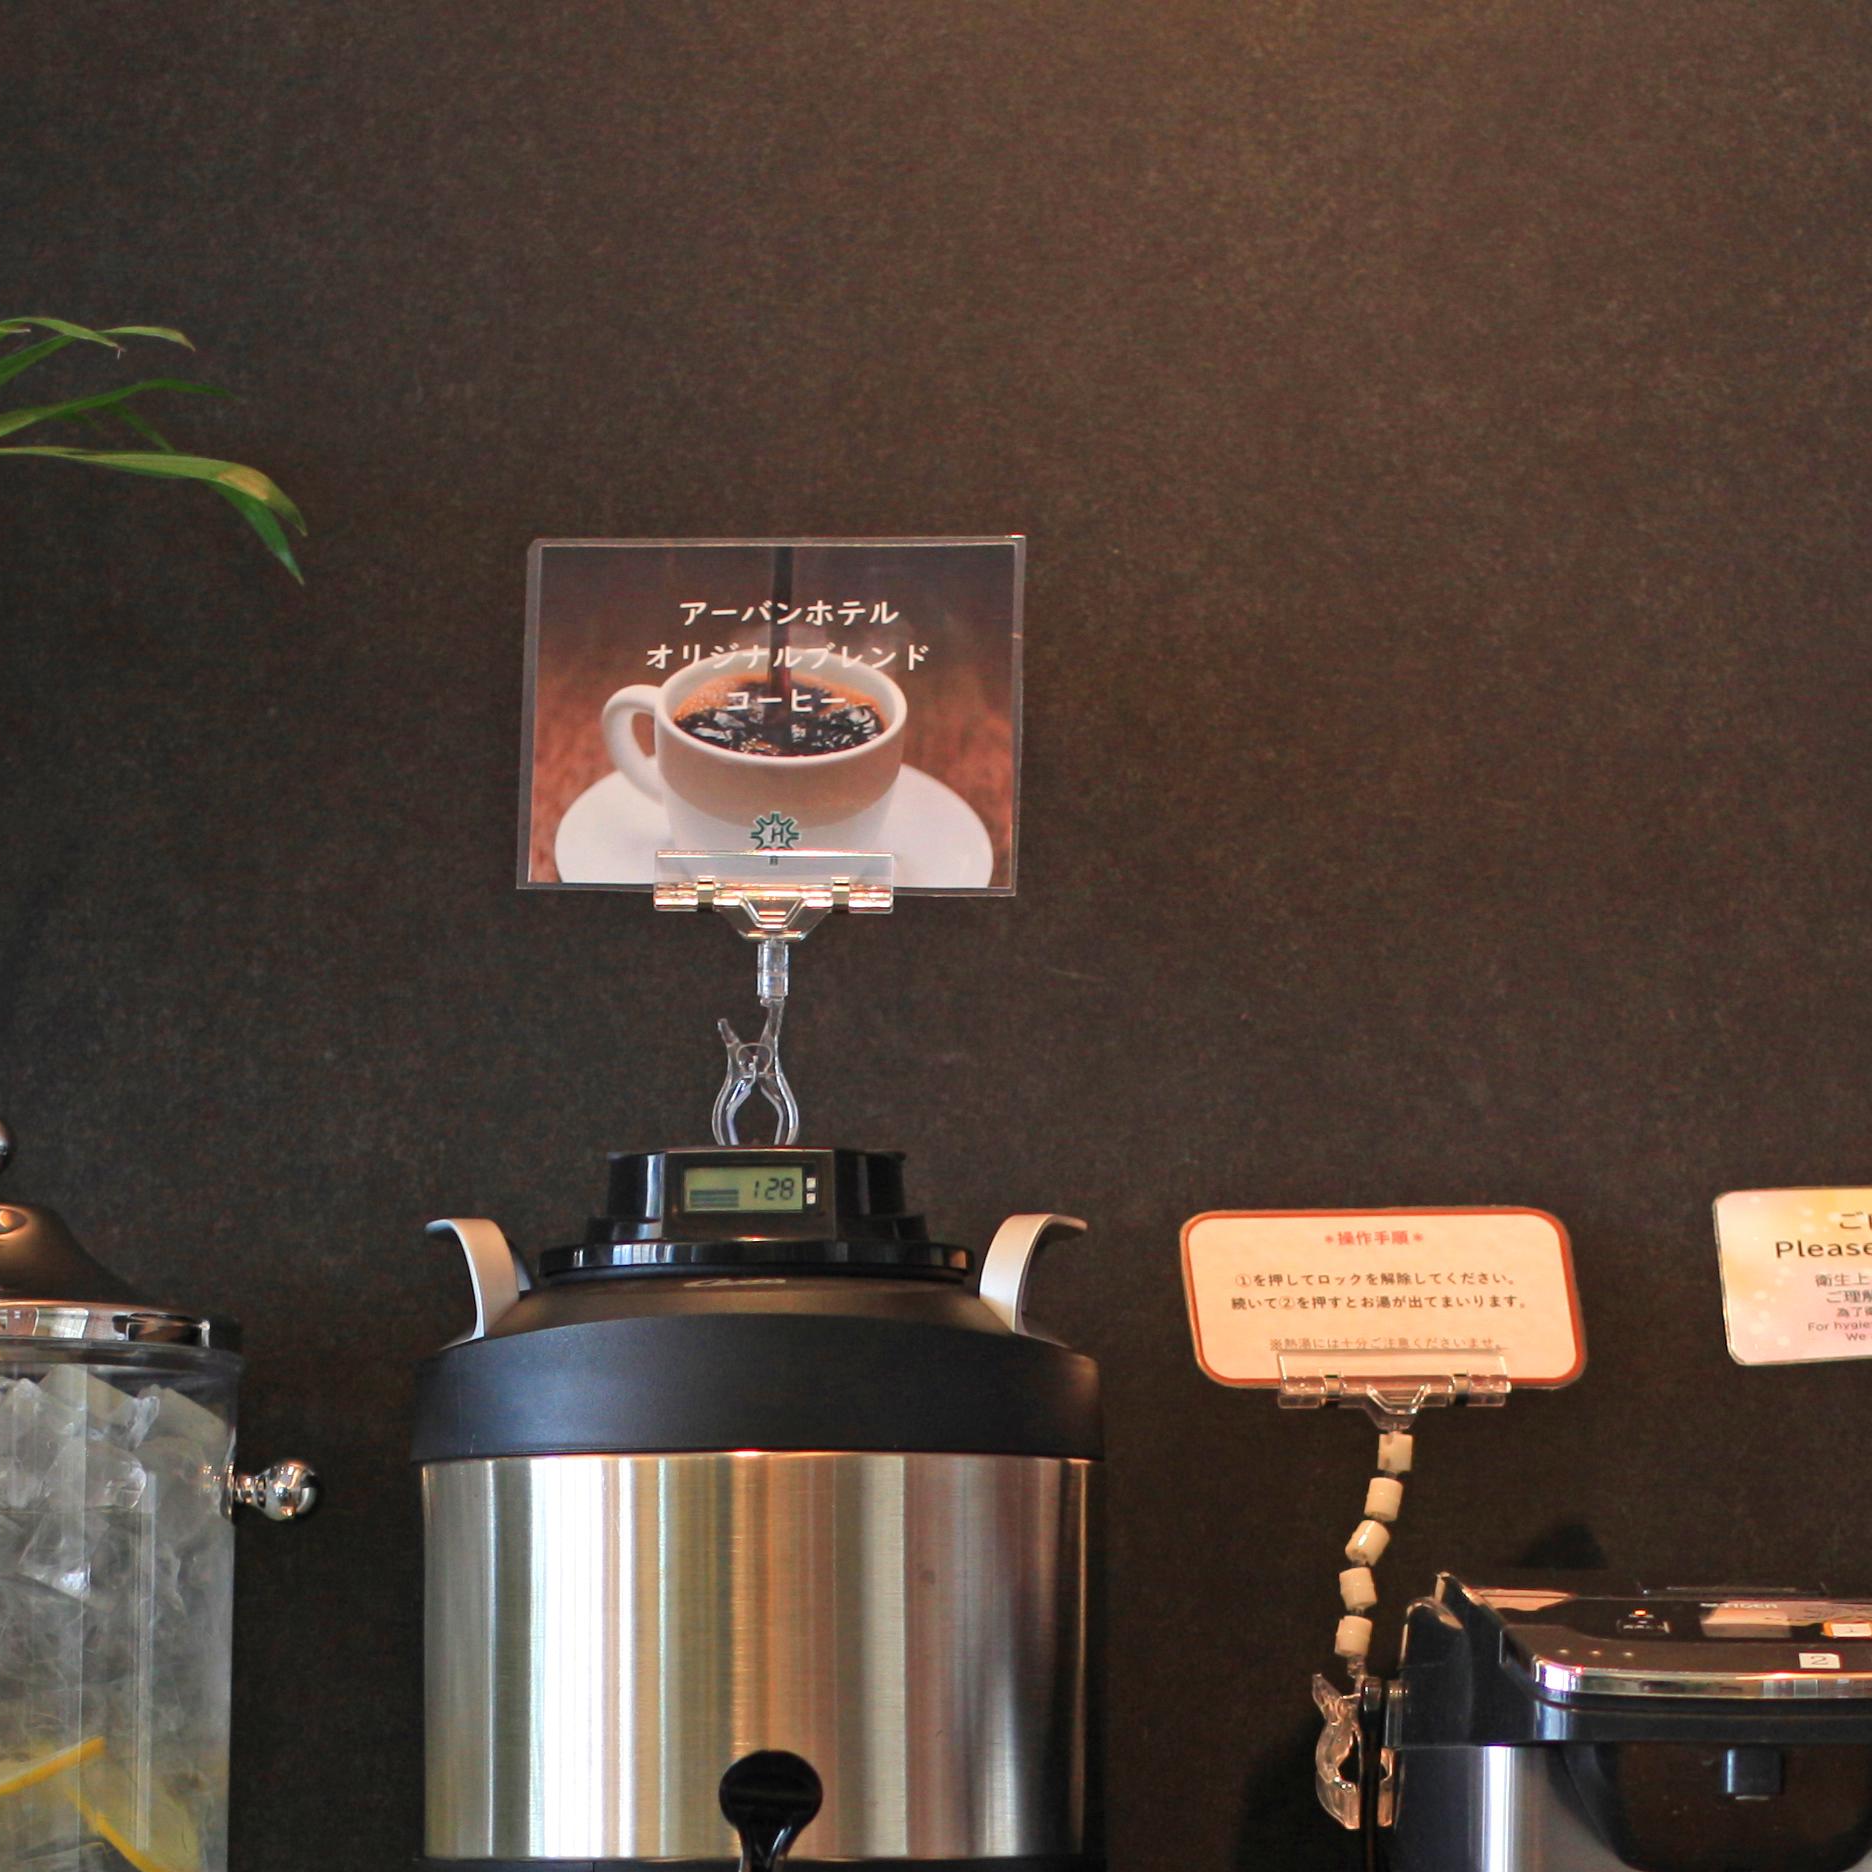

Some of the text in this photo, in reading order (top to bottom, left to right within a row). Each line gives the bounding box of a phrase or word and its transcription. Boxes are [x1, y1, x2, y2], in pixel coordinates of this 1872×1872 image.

[678, 600, 900, 626] アーバンホテル
[645, 643, 930, 671] オリジナルブレンド
[725, 688, 847, 713] コーヒー
[752, 1177, 796, 1201] 128
[1846, 1332, 1867, 1342] We
